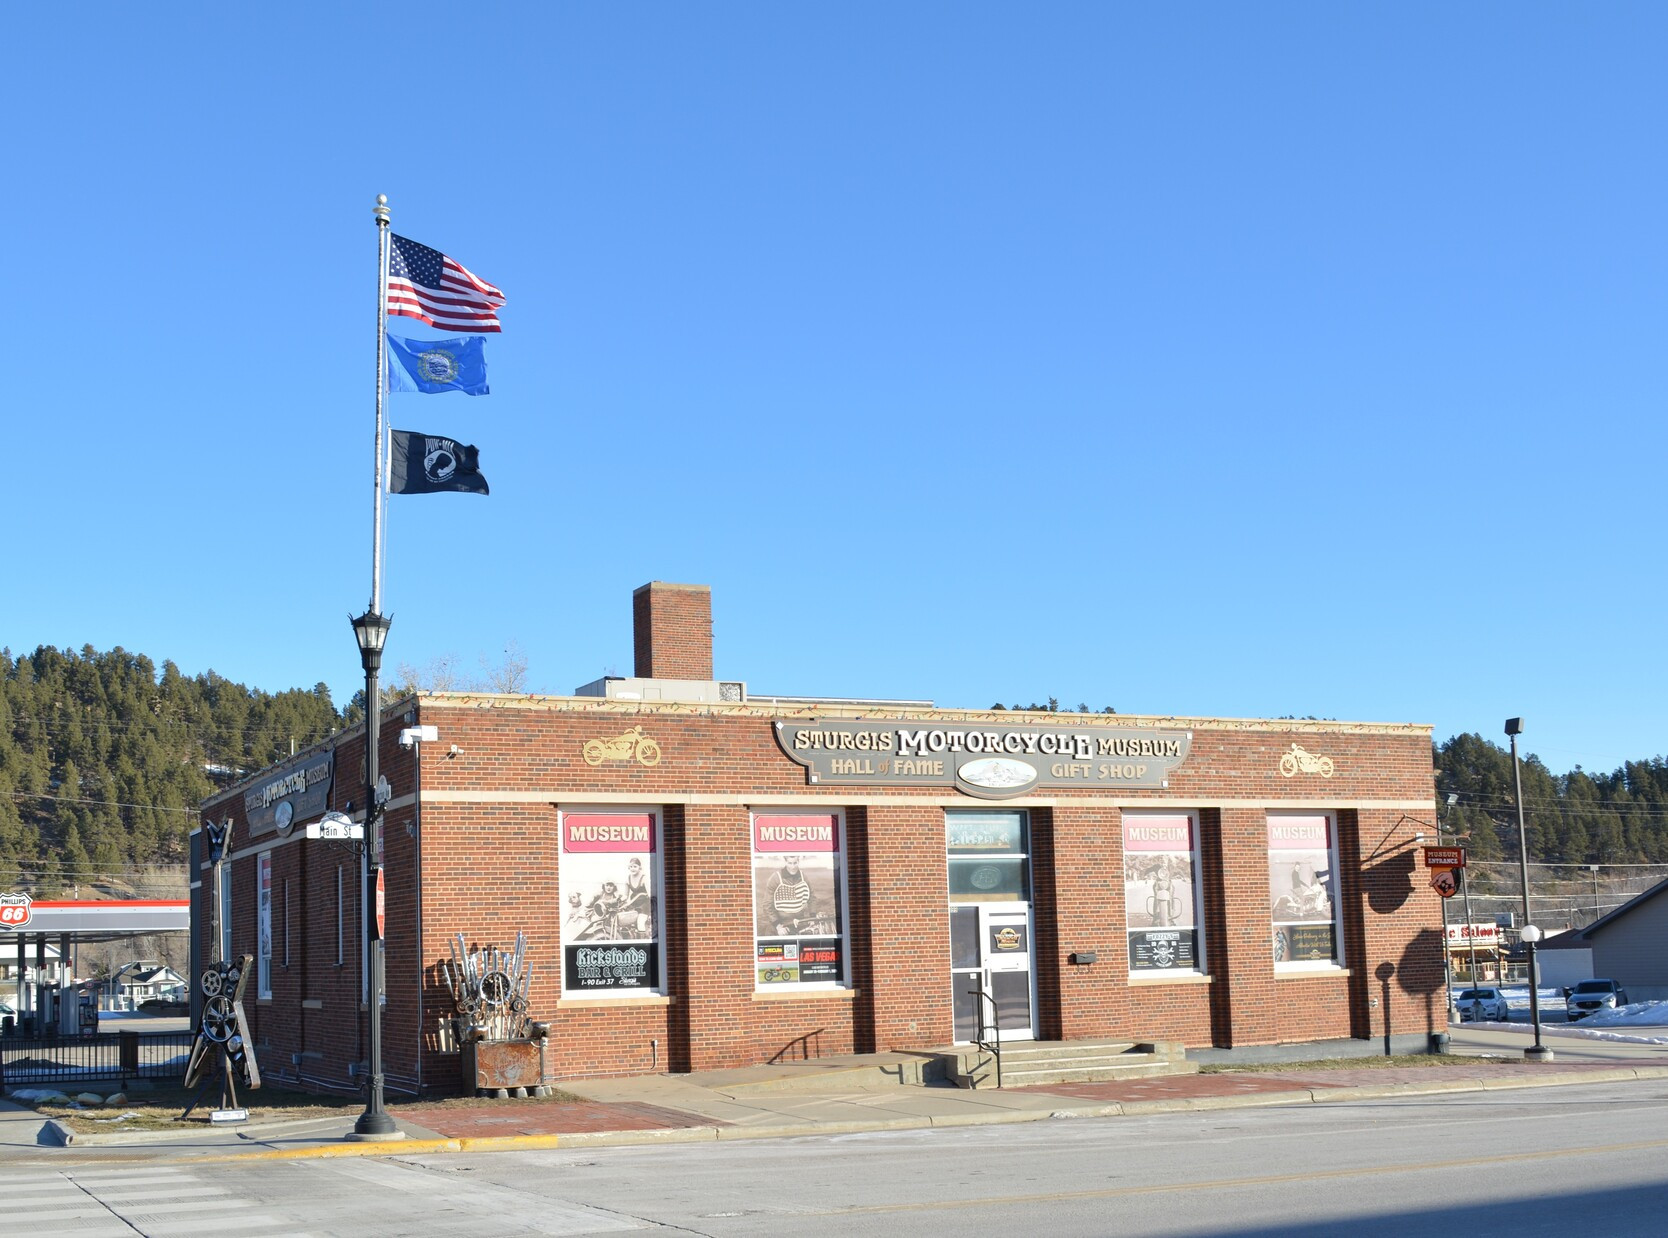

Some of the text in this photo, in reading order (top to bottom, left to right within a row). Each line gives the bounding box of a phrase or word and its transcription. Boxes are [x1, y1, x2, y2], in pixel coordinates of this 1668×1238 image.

[793, 730, 1182, 761] STURGIS MOTORCYCLE MUSEUM
[831, 759, 944, 776] HALL of FAME
[1051, 763, 1148, 780] GIFT SHOP
[320, 826, 338, 837] Main
[569, 826, 648, 842] MUSEUM
[759, 826, 832, 842] MUSEUM
[1128, 827, 1188, 841] MUSEUM
[1272, 826, 1326, 840] MUSEUM
[2, 907, 25, 921] 66
[576, 947, 647, 967] Kickstands
[800, 952, 814, 962] LAS
[578, 966, 646, 978] BAR & GRILL
